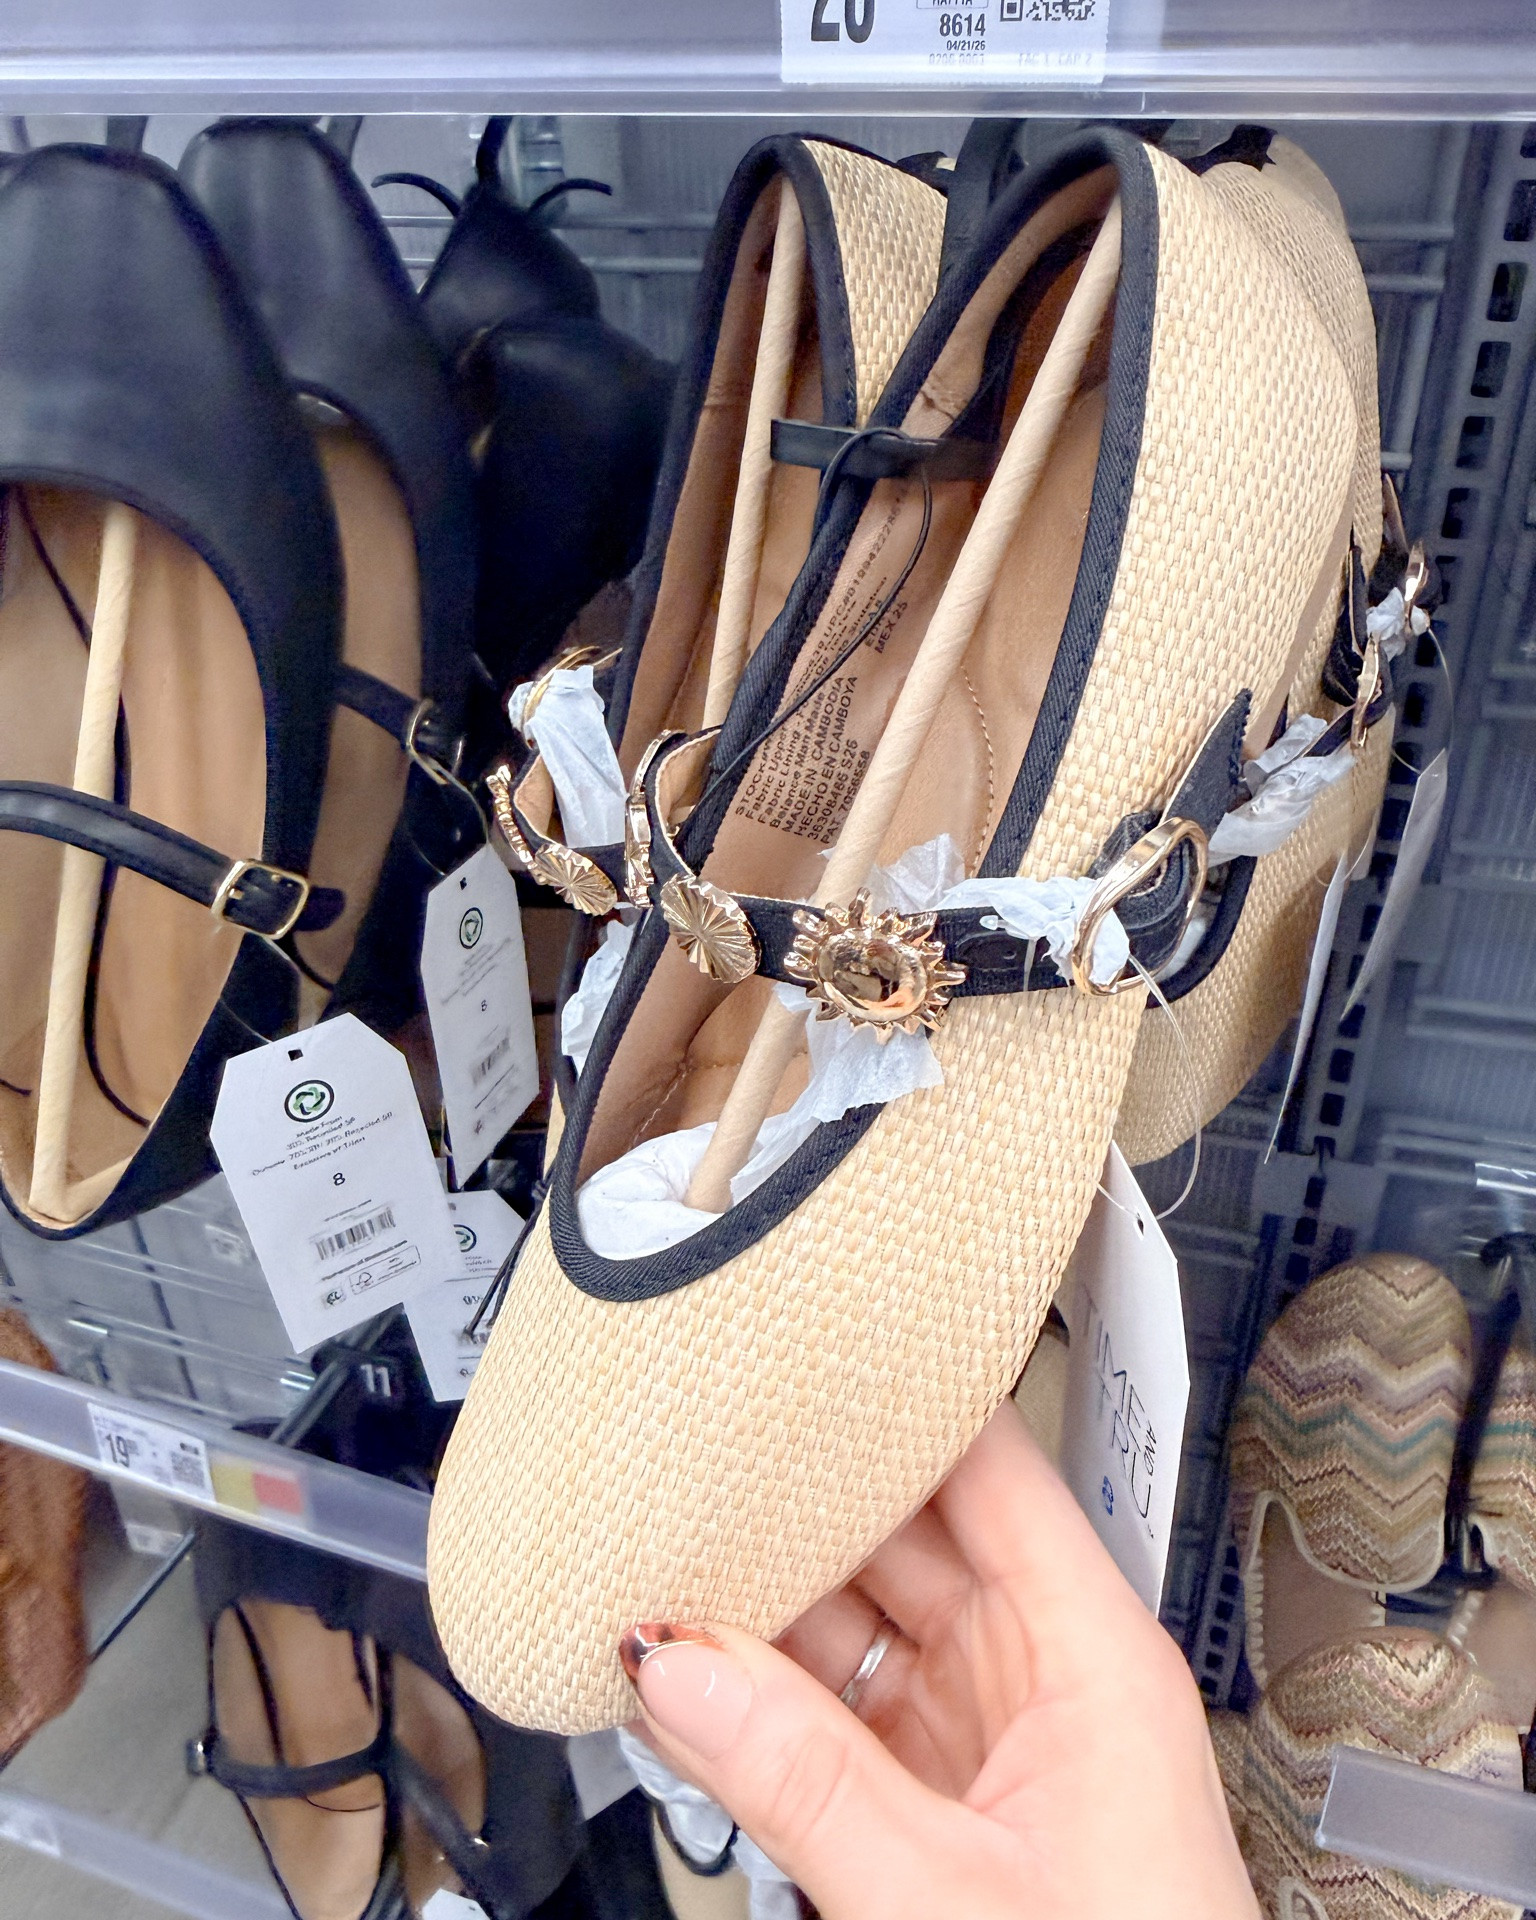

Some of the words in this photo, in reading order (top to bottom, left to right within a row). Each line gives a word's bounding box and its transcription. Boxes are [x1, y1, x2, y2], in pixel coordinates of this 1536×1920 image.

[939, 13, 986, 37] 8614
[946, 40, 986, 51] 04/21/26
[874, 620, 897, 654] MEX
[896, 602, 908, 620] 25
[828, 675, 858, 754] CAMBOYA
[782, 789, 812, 833] MADE
[804, 768, 818, 790] IN
[811, 677, 844, 761] CAMBODIA
[822, 755, 837, 780] EN
[793, 782, 828, 836] HECHO
[332, 1172, 346, 1187] 8
[105, 1433, 131, 1468] 19
[1143, 1418, 1157, 1477] AND
